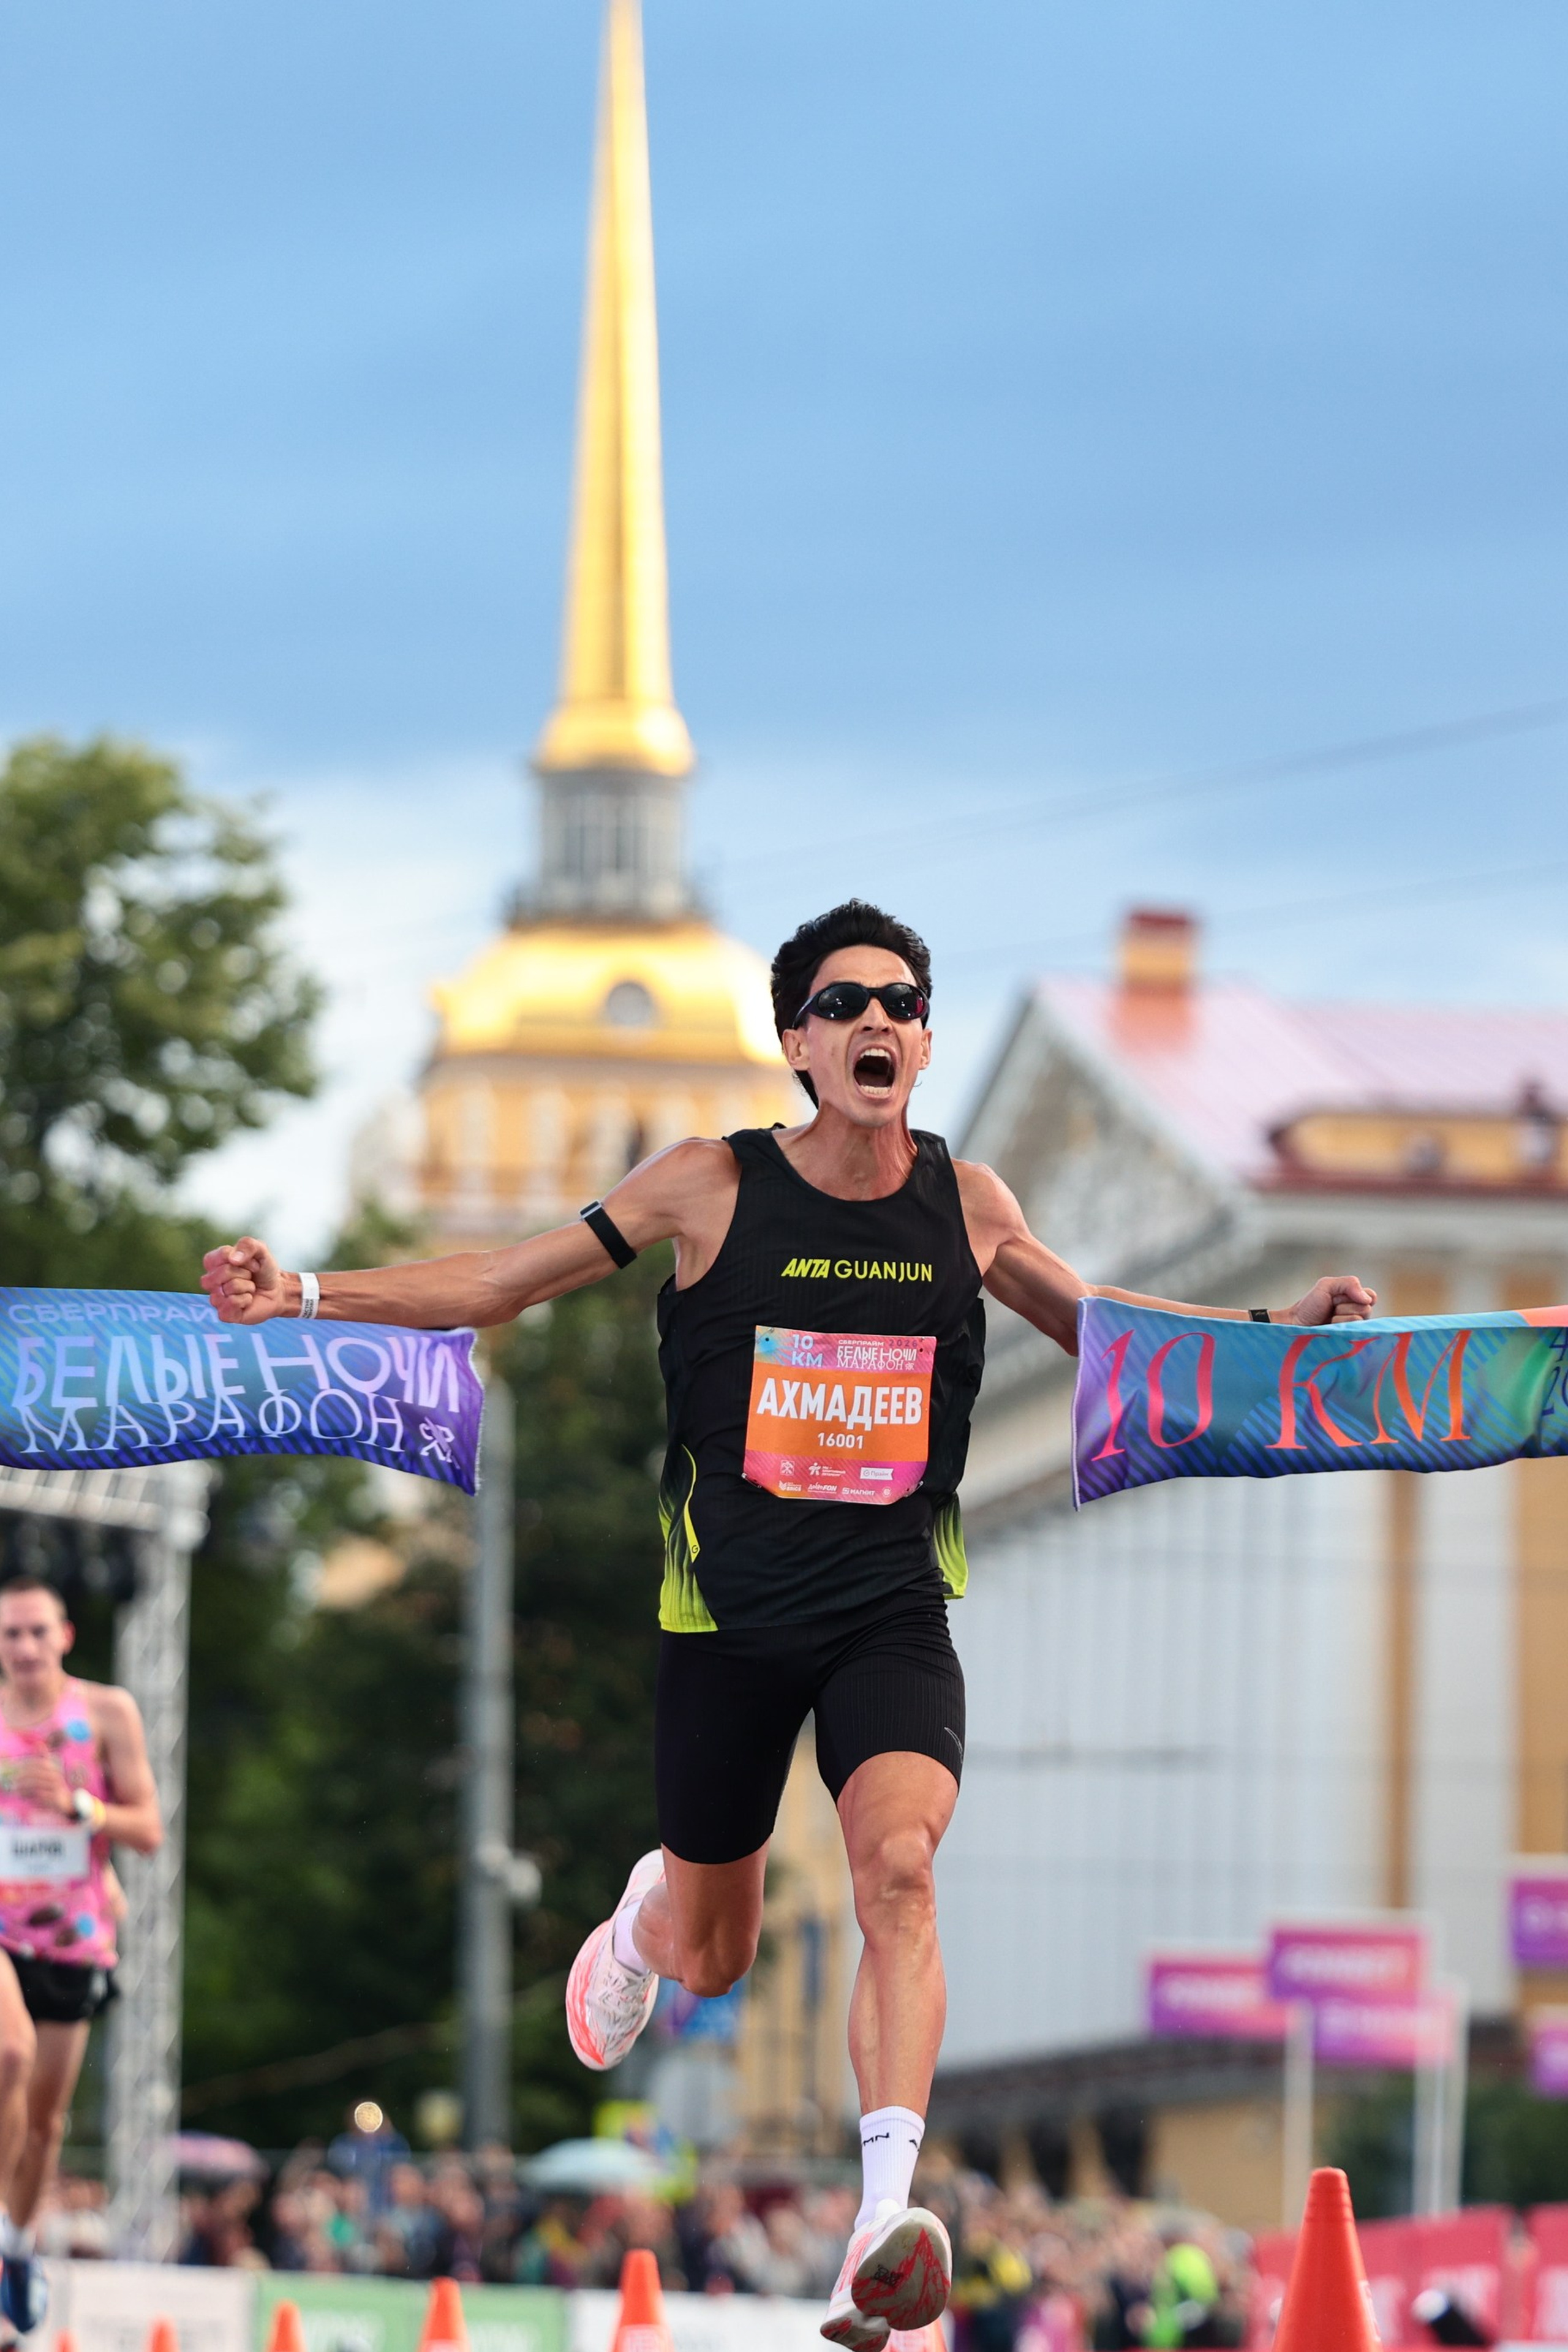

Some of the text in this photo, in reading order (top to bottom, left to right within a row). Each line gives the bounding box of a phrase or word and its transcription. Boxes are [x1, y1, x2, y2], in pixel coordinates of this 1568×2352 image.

[781, 1259, 932, 1282] ANTA GUANJUN
[8, 1303, 219, 1324] СБЕРПРАЙ
[792, 1334, 814, 1350] 10
[889, 1339, 918, 1348] 2026
[791, 1351, 823, 1368] КМ
[836, 1357, 903, 1370] МАРАФОН
[837, 1346, 918, 1362] БЕЛЫЕ НОЧИ
[11, 1332, 460, 1413] БЕЛЫЕ НОЧИ
[756, 1378, 922, 1431] АХМАДЕЕВ
[1091, 1329, 1216, 1461] 10
[20, 1389, 405, 1454] МАРАФОН
[817, 1432, 864, 1449] 16001
